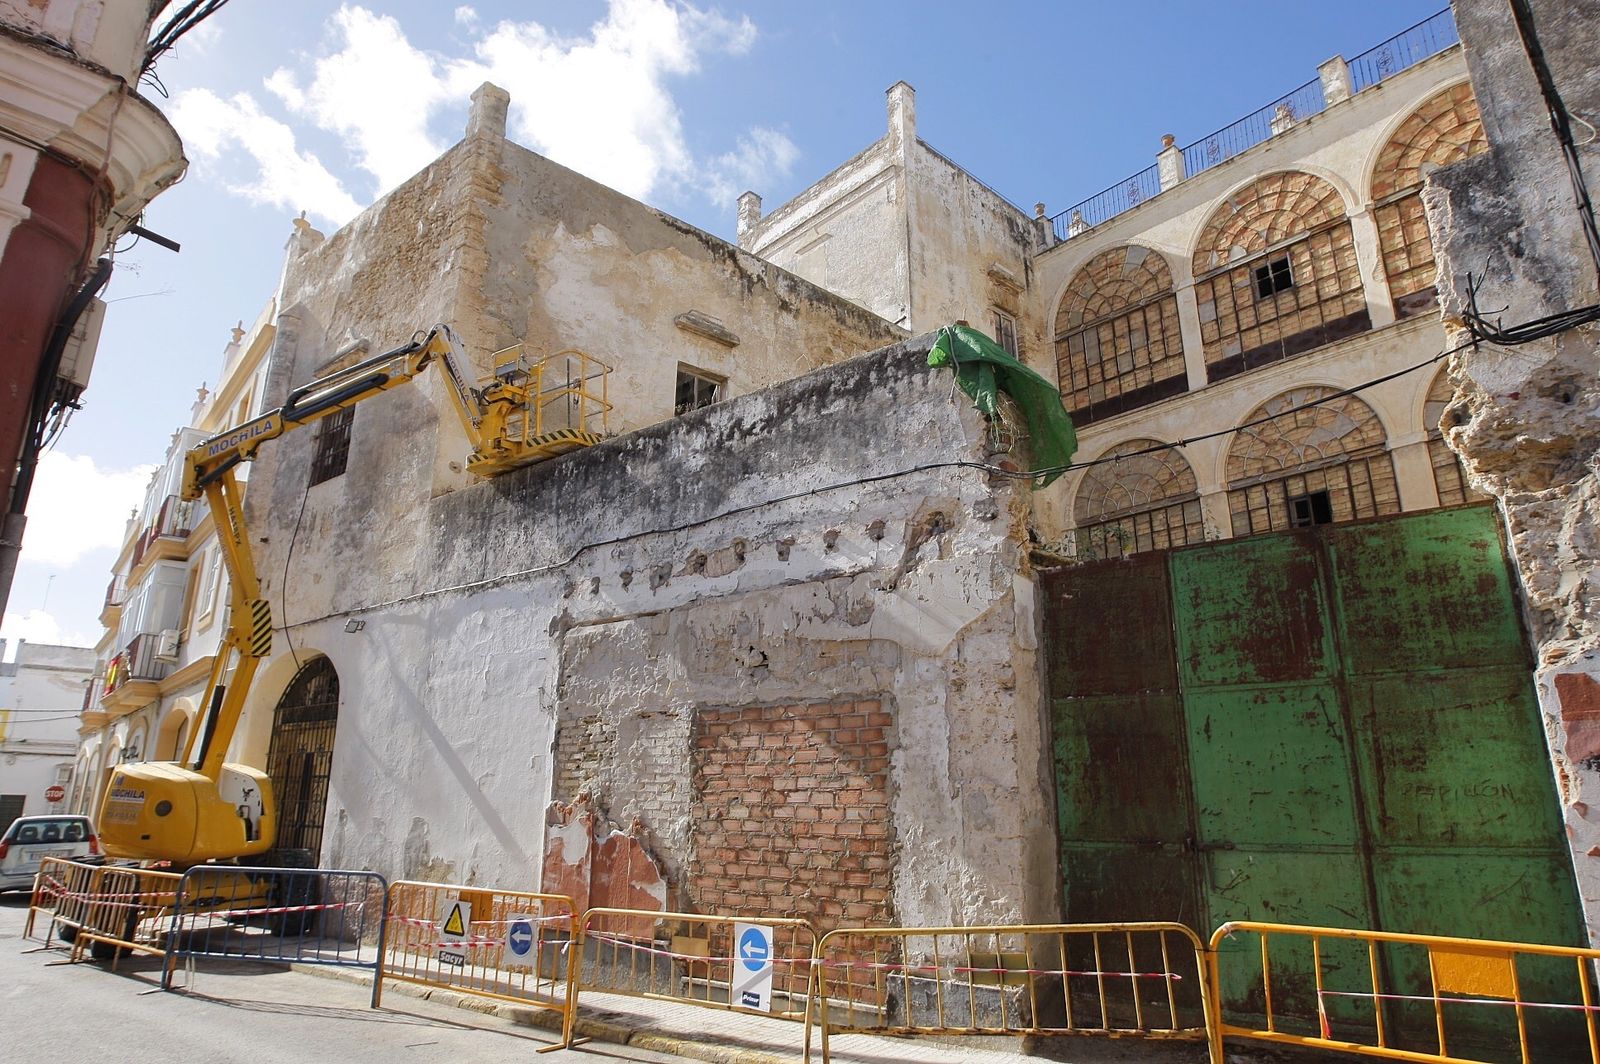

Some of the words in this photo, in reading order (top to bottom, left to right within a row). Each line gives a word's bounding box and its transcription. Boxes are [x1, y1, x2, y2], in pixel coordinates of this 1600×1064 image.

[447, 352, 470, 401] MOCHILA
[208, 420, 273, 456] MOCHILA
[46, 790, 64, 798] STOP
